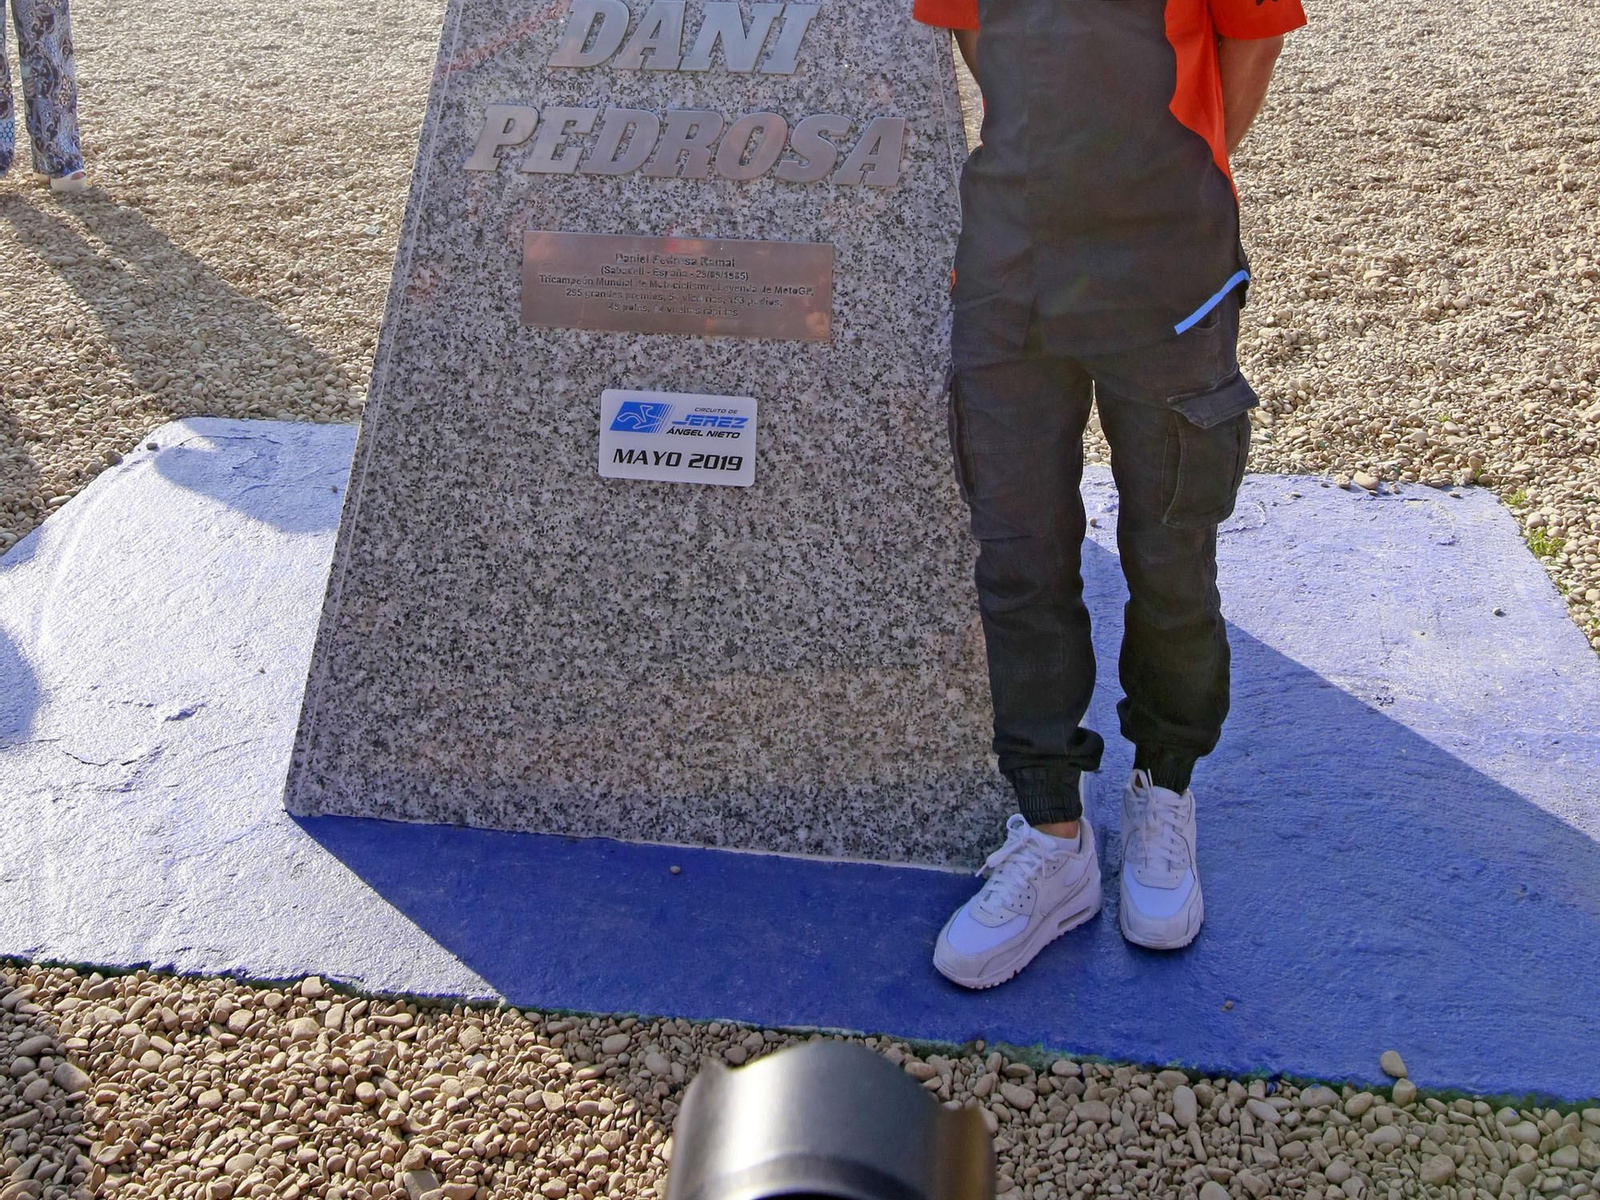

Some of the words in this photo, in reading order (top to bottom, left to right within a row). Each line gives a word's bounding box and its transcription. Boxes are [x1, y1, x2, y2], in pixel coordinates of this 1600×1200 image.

[463, 105, 905, 186] PEDROSA
[671, 414, 749, 429] JEREZ
[666, 425, 704, 437] ÁNGEL
[706, 430, 741, 439] NIETO
[612, 448, 682, 467] MAYO
[687, 453, 743, 471] 2019
